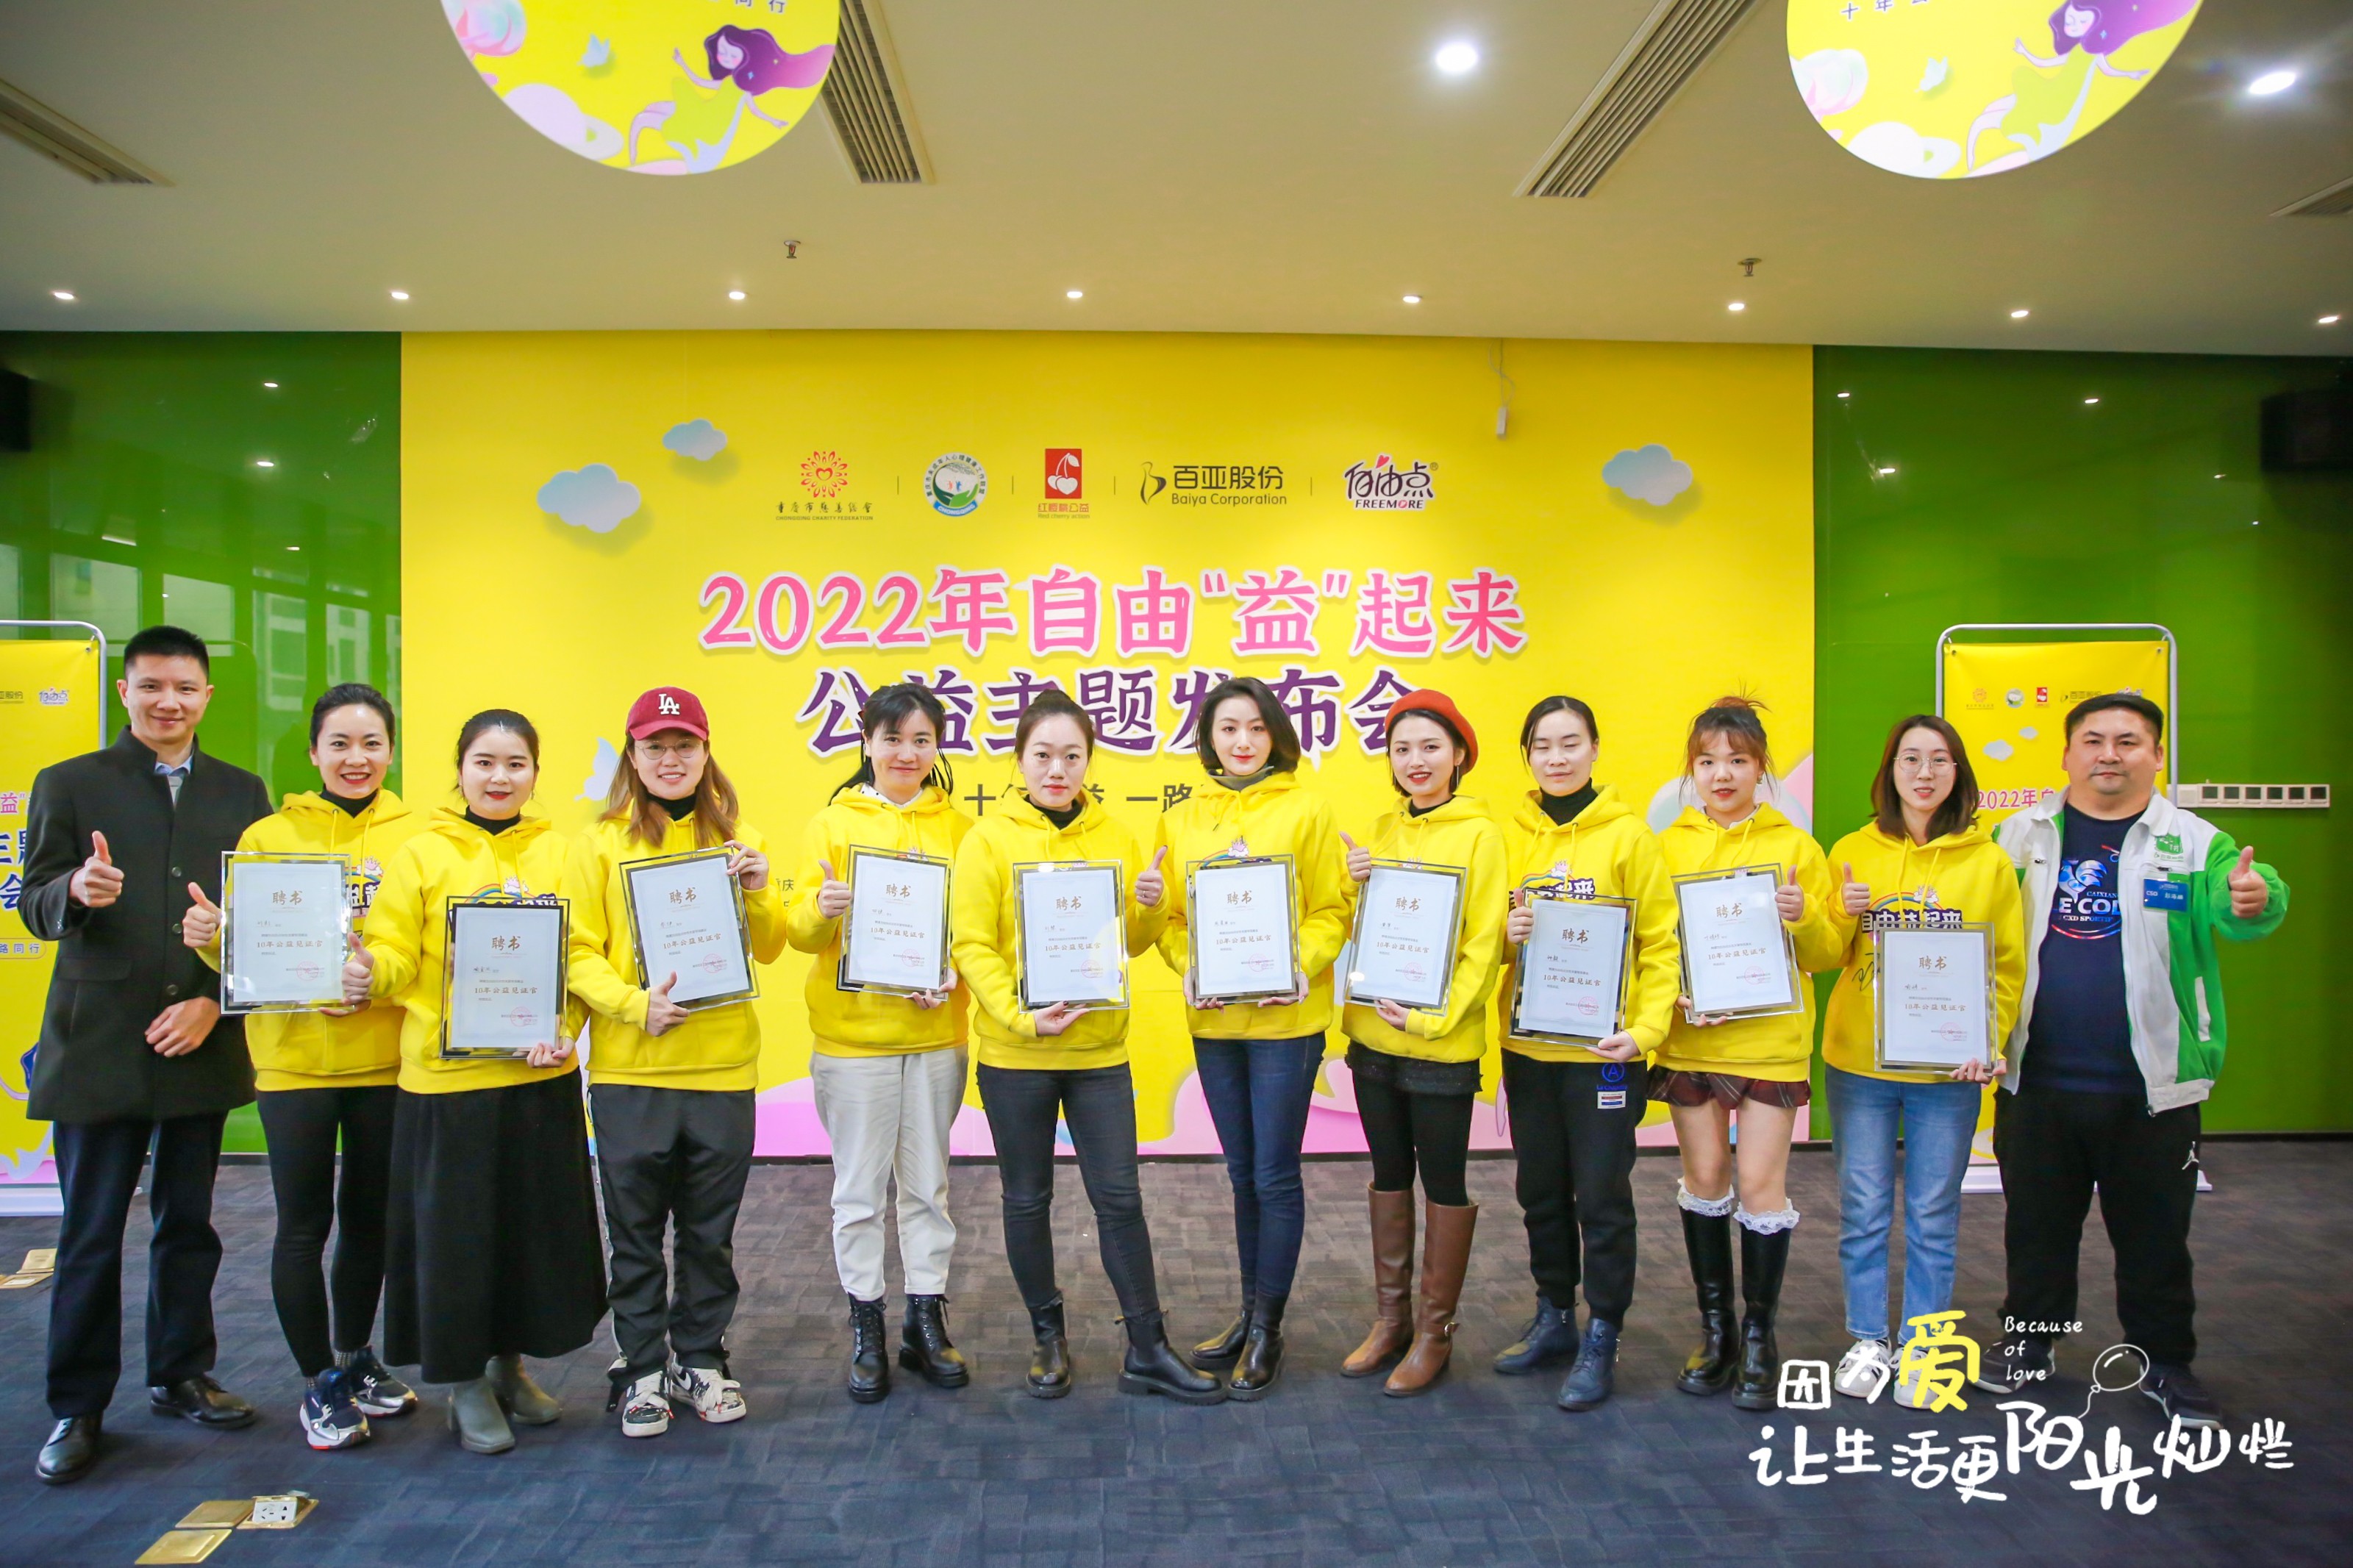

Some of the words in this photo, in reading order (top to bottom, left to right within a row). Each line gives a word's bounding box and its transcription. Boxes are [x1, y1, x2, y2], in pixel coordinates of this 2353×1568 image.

[1174, 465, 1284, 490] 百亚股份
[1171, 493, 1207, 507] Baiya
[1210, 493, 1287, 507] Corporation
[1355, 500, 1424, 509] FREEMORE
[658, 693, 680, 715] LA
[272, 890, 303, 905] 聘书
[669, 887, 697, 904] 聘书
[885, 883, 911, 898] 聘书
[1227, 890, 1252, 904] 聘书
[1056, 896, 1082, 911] 聘书
[1396, 896, 1421, 912] 聘书
[1715, 903, 1743, 918] 聘书
[871, 927, 925, 939] 10年公益见证官
[1215, 934, 1271, 945] 10年公益见证官
[1562, 928, 1589, 944] 聘书
[257, 939, 323, 948] 10年公益见证官
[491, 935, 521, 951] 聘书
[663, 933, 721, 950] 10年公益见证官
[1045, 942, 1101, 952] 10年公益见证官
[1377, 941, 1429, 954] 10年公益见证官
[1708, 947, 1766, 960] 10年公益见证官
[1919, 956, 1947, 970] 聘书
[1543, 974, 1602, 987] 10年公益见证官
[1904, 1003, 1966, 1012] 10年公益见证官
